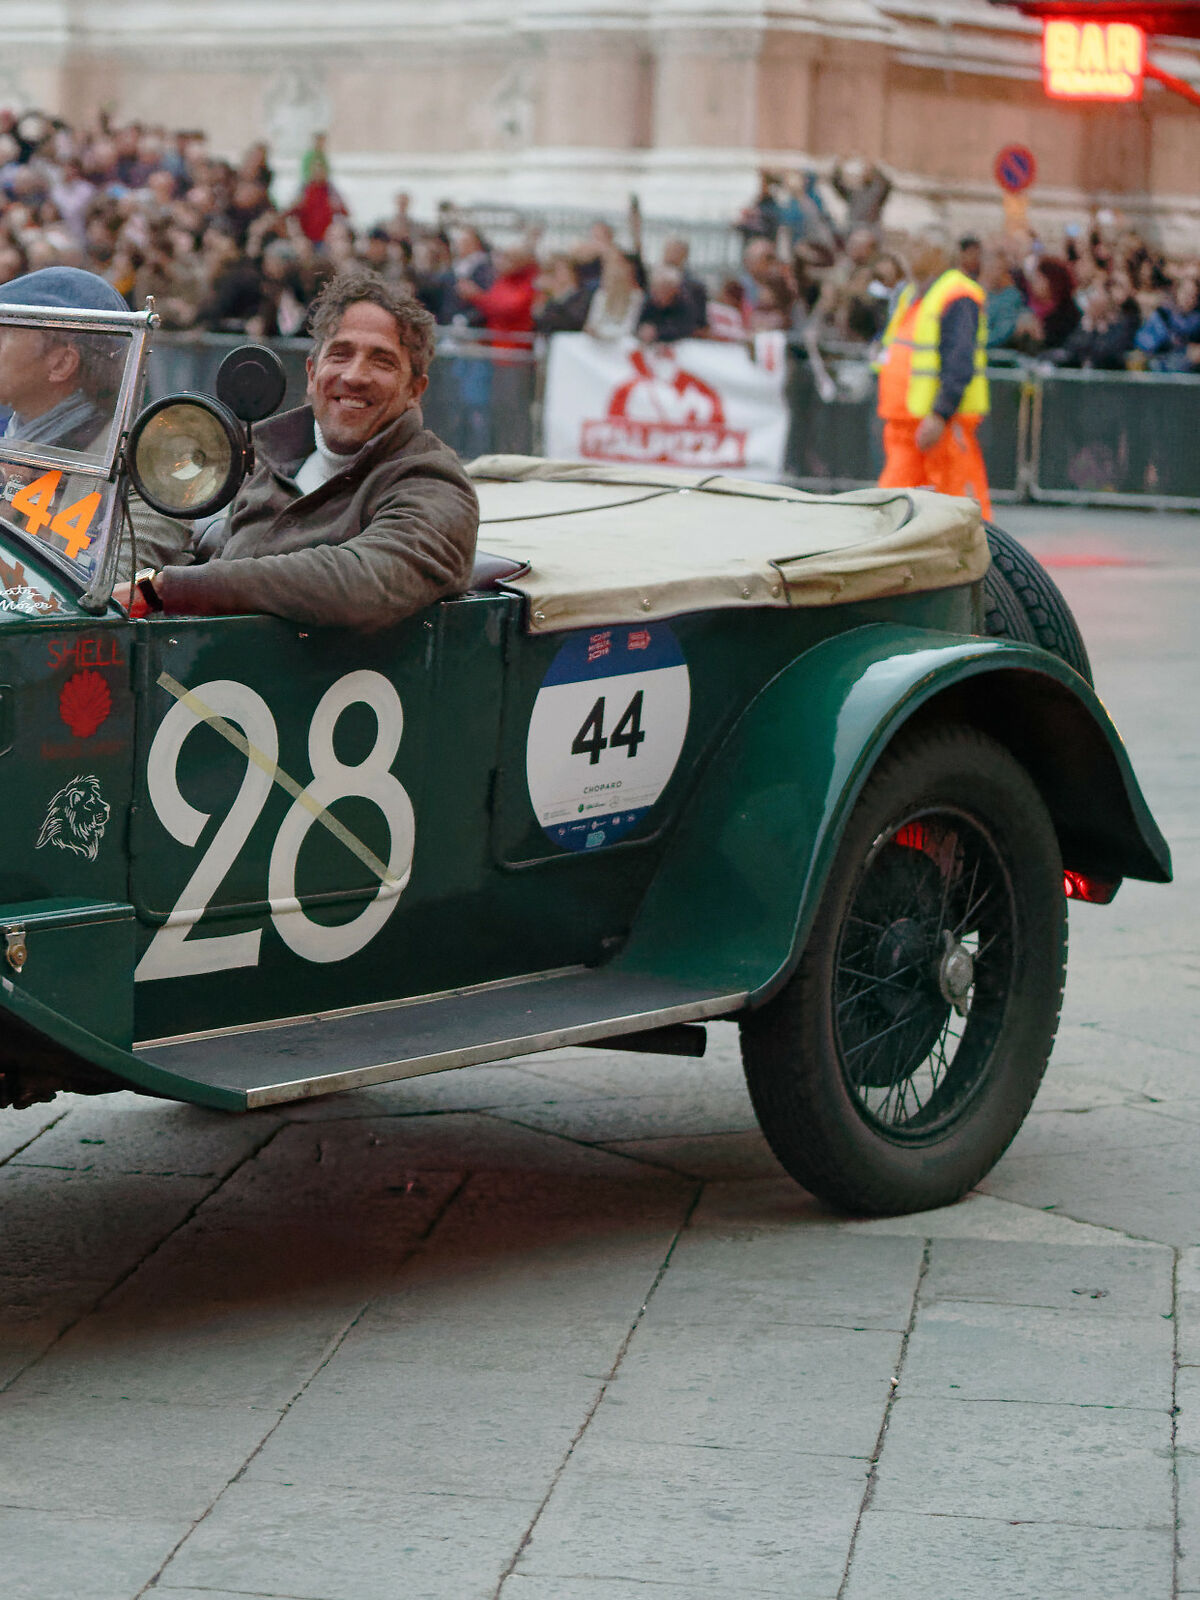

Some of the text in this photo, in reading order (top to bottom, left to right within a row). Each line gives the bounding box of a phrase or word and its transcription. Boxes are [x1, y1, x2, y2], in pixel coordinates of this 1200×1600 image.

[1045, 21, 1140, 75] BAR
[10, 470, 102, 559] 44
[47, 639, 125, 669] SHELL
[571, 690, 645, 765] 44
[583, 780, 623, 794] CHOPARD
[134, 669, 415, 982] 28
